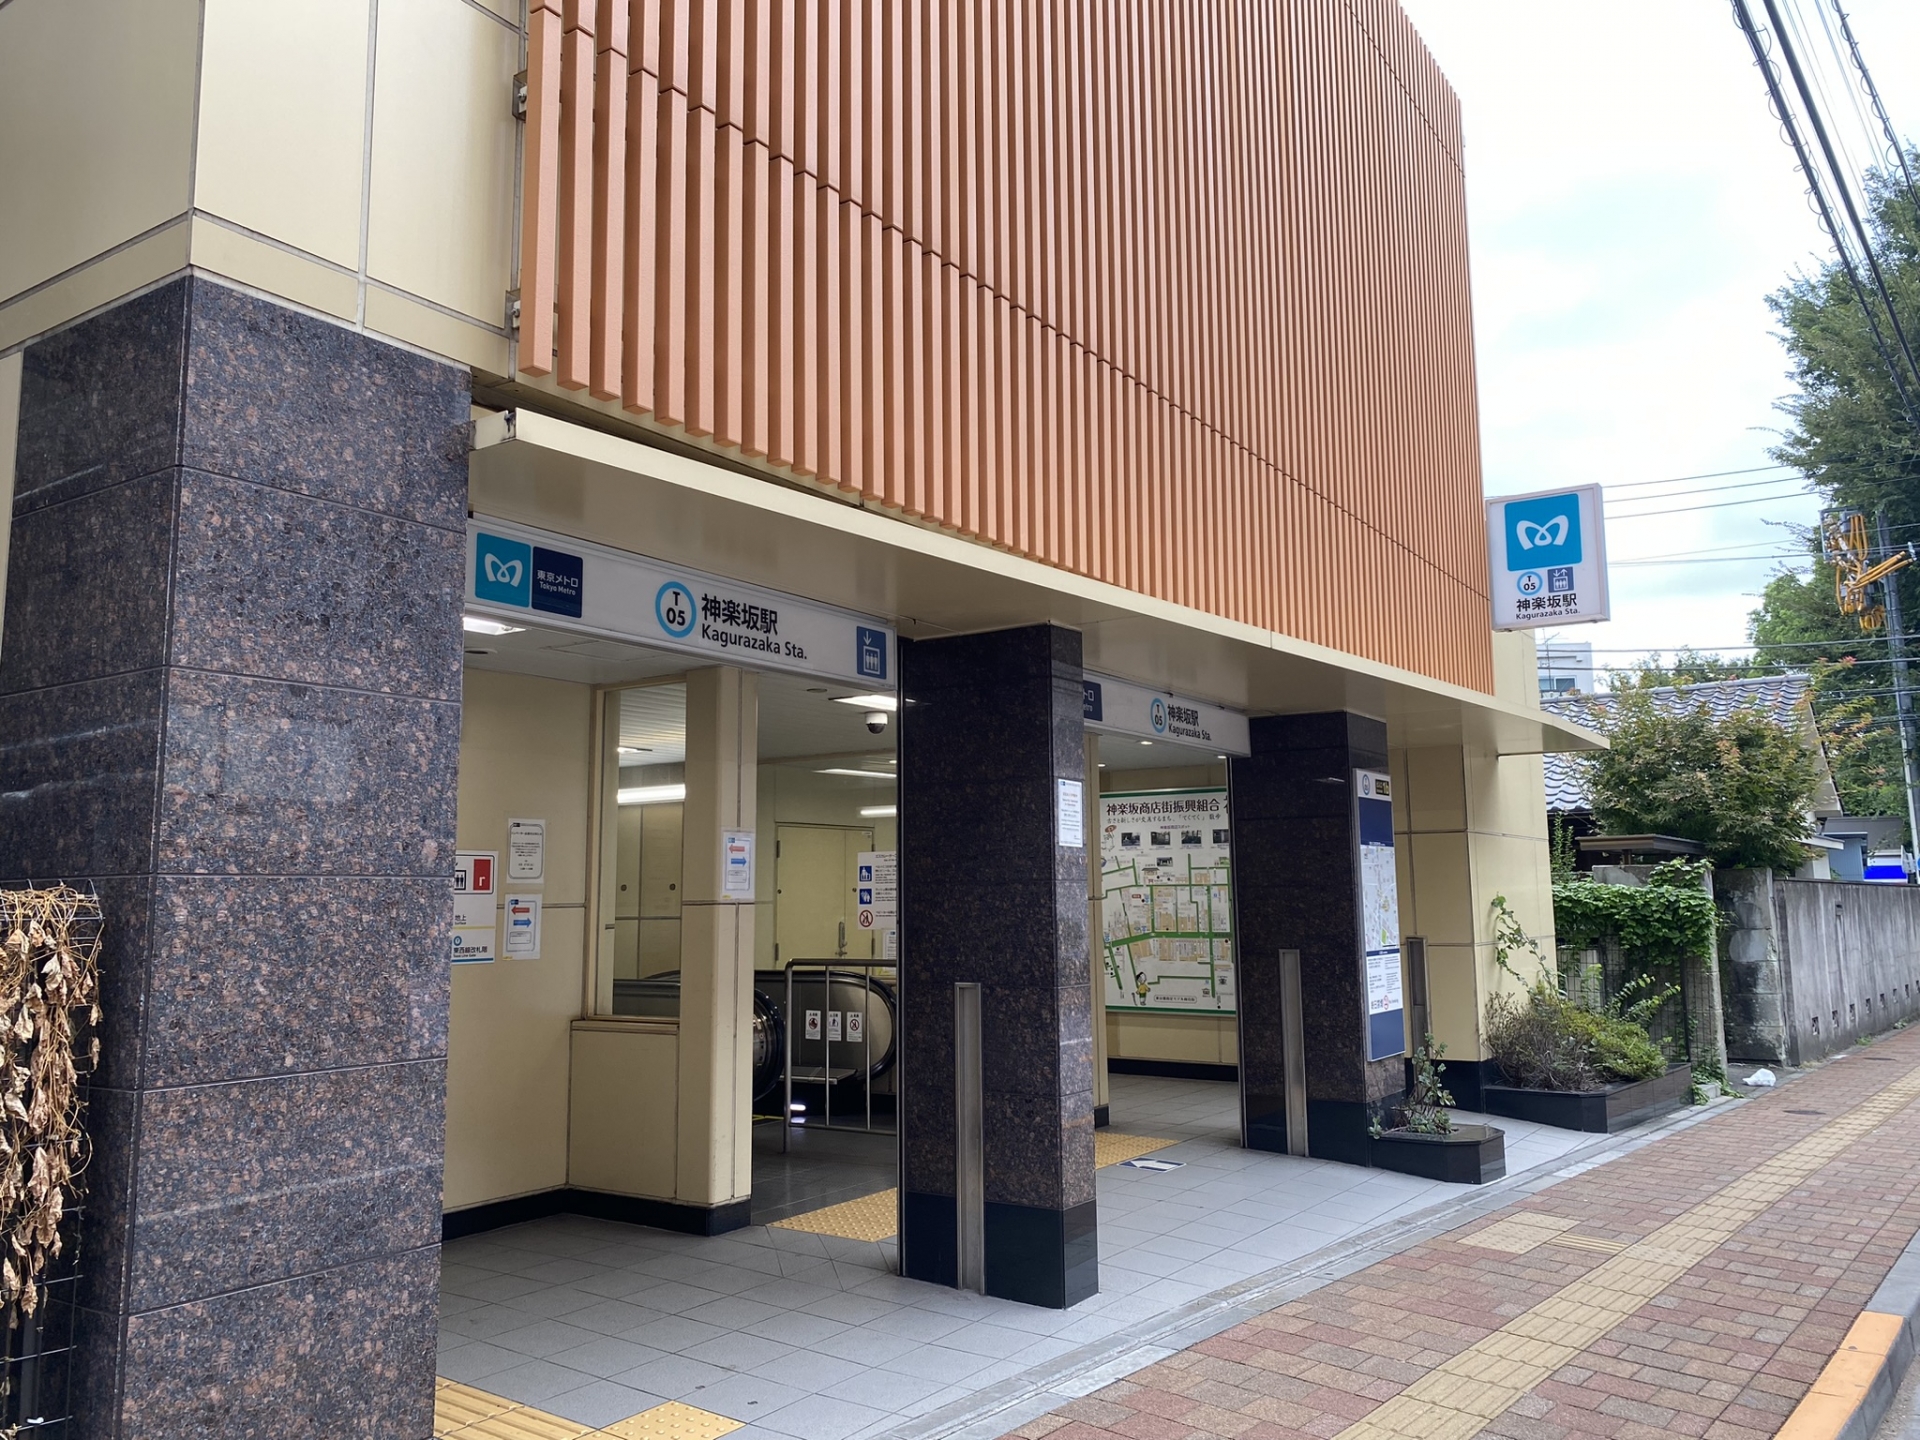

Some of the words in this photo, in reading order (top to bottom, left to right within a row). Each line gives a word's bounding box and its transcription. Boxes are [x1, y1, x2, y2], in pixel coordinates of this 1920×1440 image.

[537, 569, 578, 588] 東京メトロ
[1523, 582, 1536, 591] 05
[539, 581, 557, 592] Tokyo
[558, 585, 576, 596] Metro
[672, 591, 681, 606] T
[1516, 593, 1577, 612] 神楽坂駅
[666, 607, 686, 626] 05
[701, 593, 778, 636] 神楽坂駅
[1515, 609, 1563, 621] Kagurazaka
[1564, 607, 1581, 615] Sta.
[701, 623, 781, 655] Kagurazaka
[784, 641, 808, 660] Sta.
[1156, 704, 1160, 714] T
[1167, 704, 1200, 727] 神楽坂駅
[1154, 714, 1163, 726] 05
[1168, 723, 1201, 739] Kagurazaka
[1201, 729, 1212, 741] Sta.
[1106, 798, 1220, 816] 神楽坂商店街振興組合
